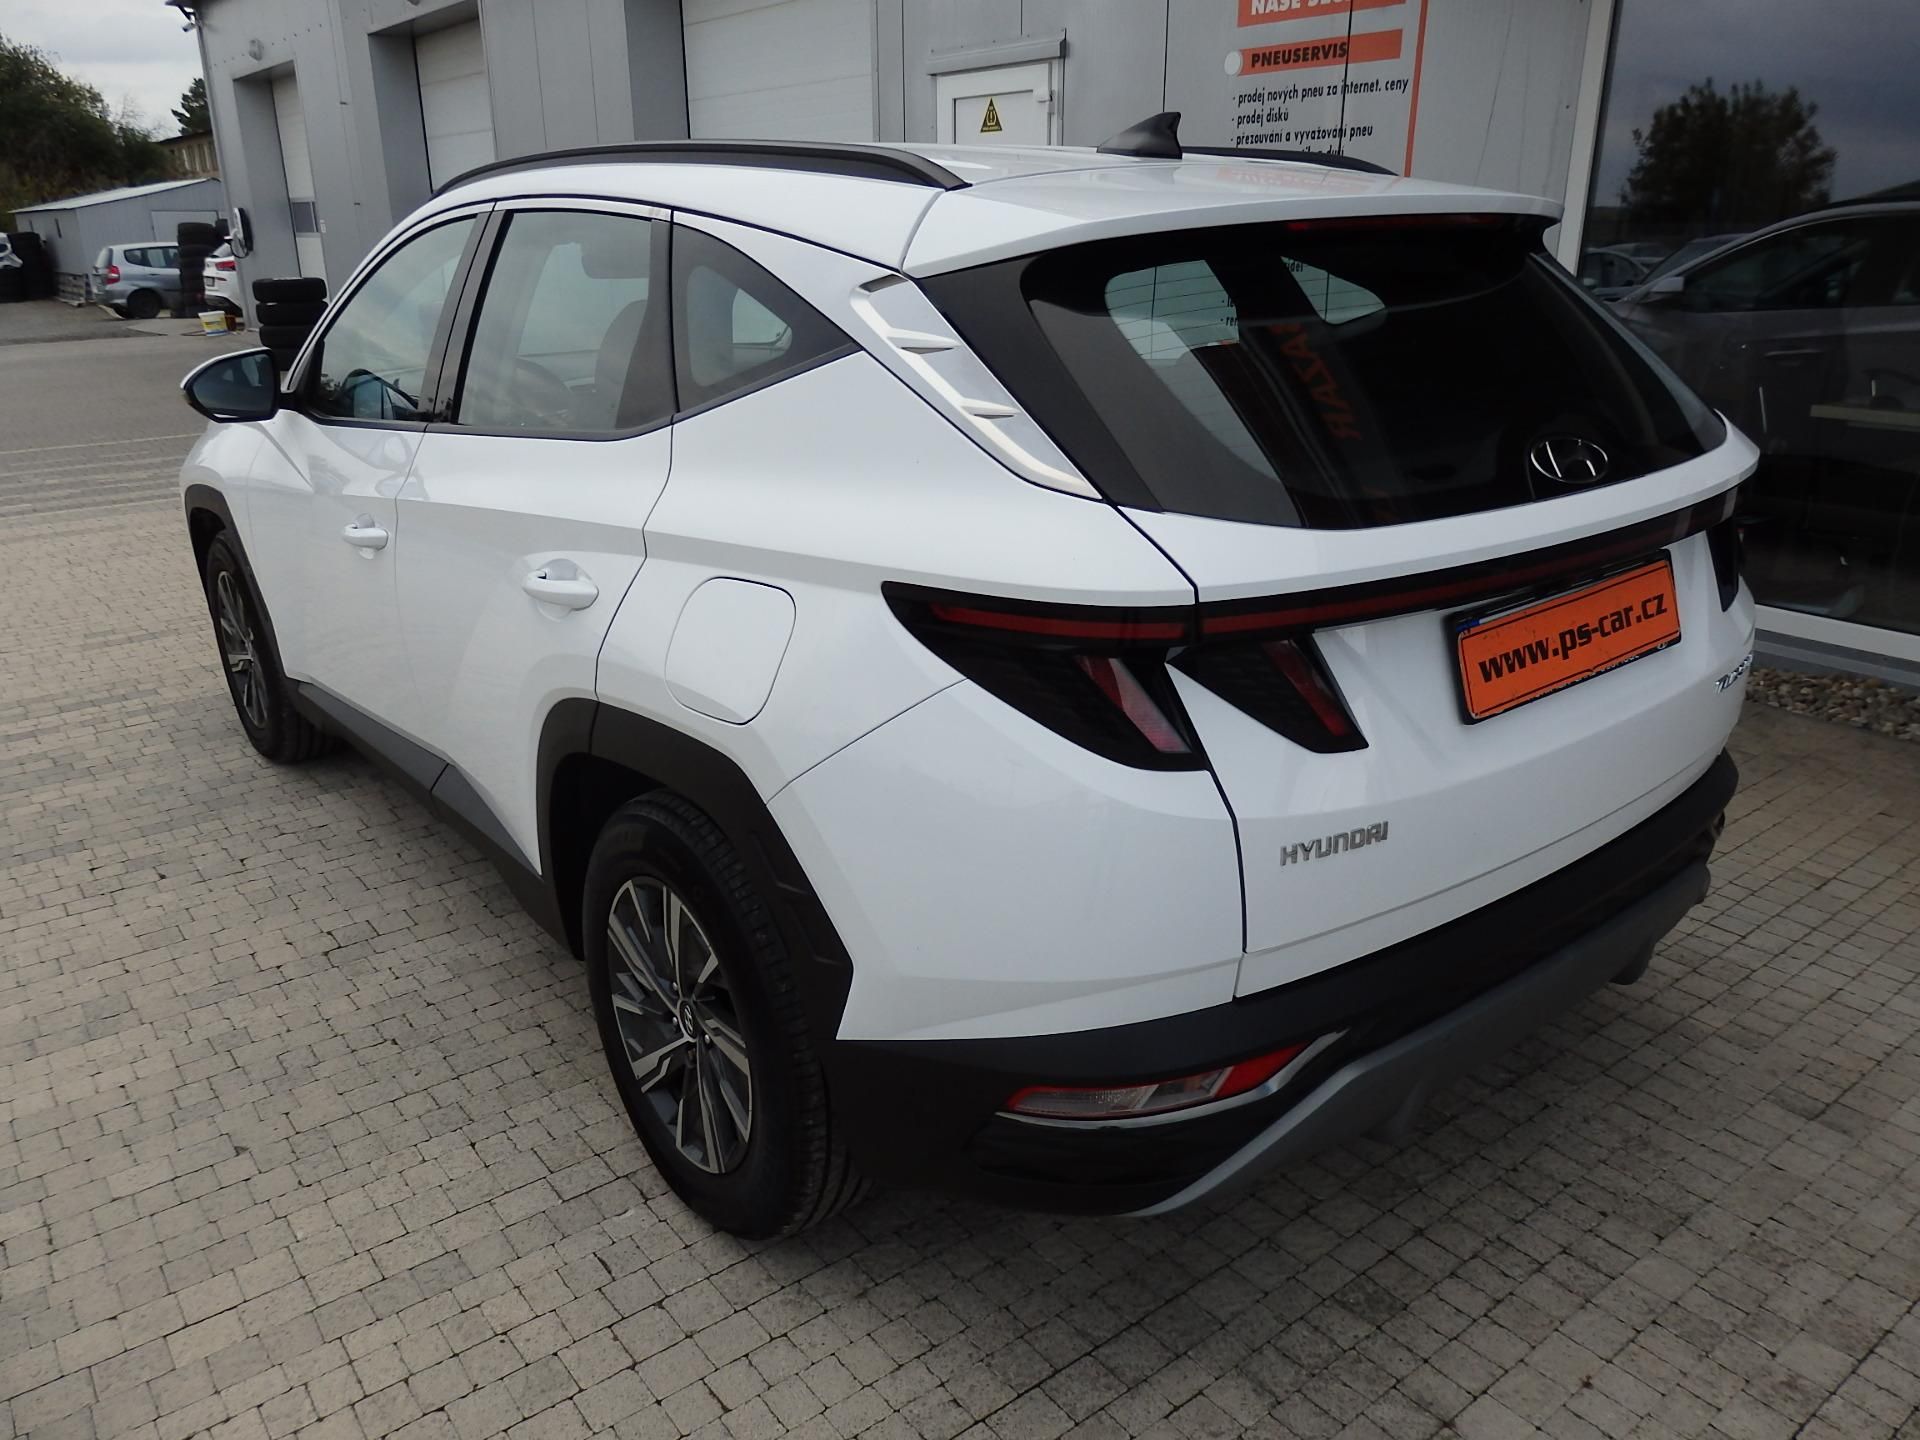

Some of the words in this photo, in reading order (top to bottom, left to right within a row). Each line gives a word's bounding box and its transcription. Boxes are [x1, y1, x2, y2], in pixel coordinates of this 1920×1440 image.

[1251, 41, 1348, 68] PNEUSERVIS
[1238, 86, 1265, 108] prodej
[1267, 83, 1299, 104] nových
[1301, 86, 1324, 102] pneu
[1326, 84, 1338, 96] za
[1385, 78, 1409, 94] ceny
[1237, 108, 1264, 128] prodej
[1285, 131, 1291, 142] a
[1349, 125, 1373, 142] pneu
[1478, 593, 1668, 683] www.ps-car.cz
[1280, 821, 1389, 867] HYUNDAI
